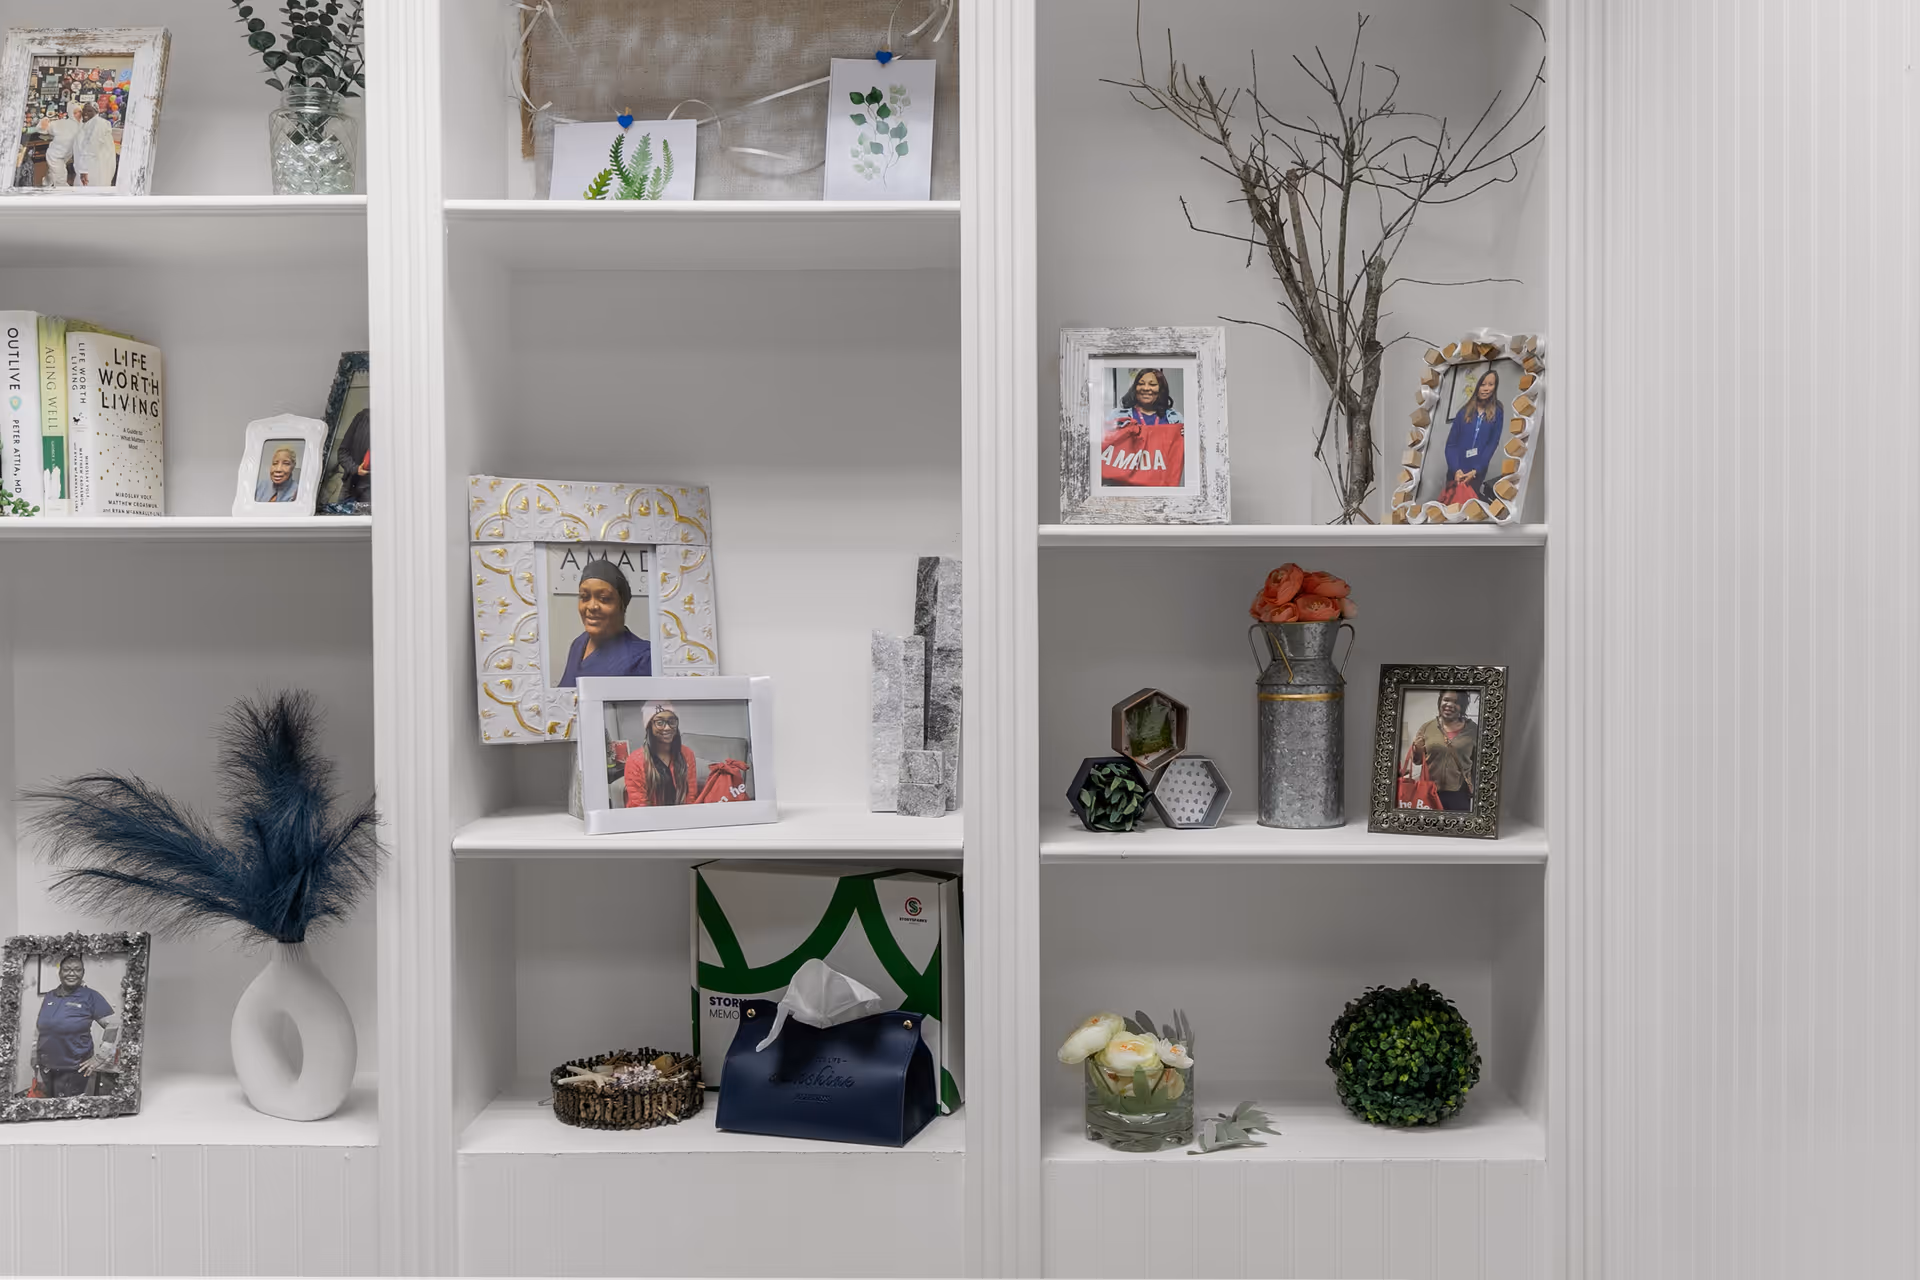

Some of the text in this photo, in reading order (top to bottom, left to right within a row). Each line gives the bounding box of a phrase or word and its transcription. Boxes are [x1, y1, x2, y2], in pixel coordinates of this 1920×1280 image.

[7, 327, 20, 391] OUTLIVE
[114, 347, 147, 371] LIFE
[45, 347, 58, 432] AGING WELL
[79, 367, 87, 404] WORTH
[98, 368, 159, 396] WORTH
[101, 391, 159, 418] LIVING
[13, 447, 21, 477] ATTIA,
[14, 479, 22, 494] MD
[709, 996, 746, 1008] STOR
